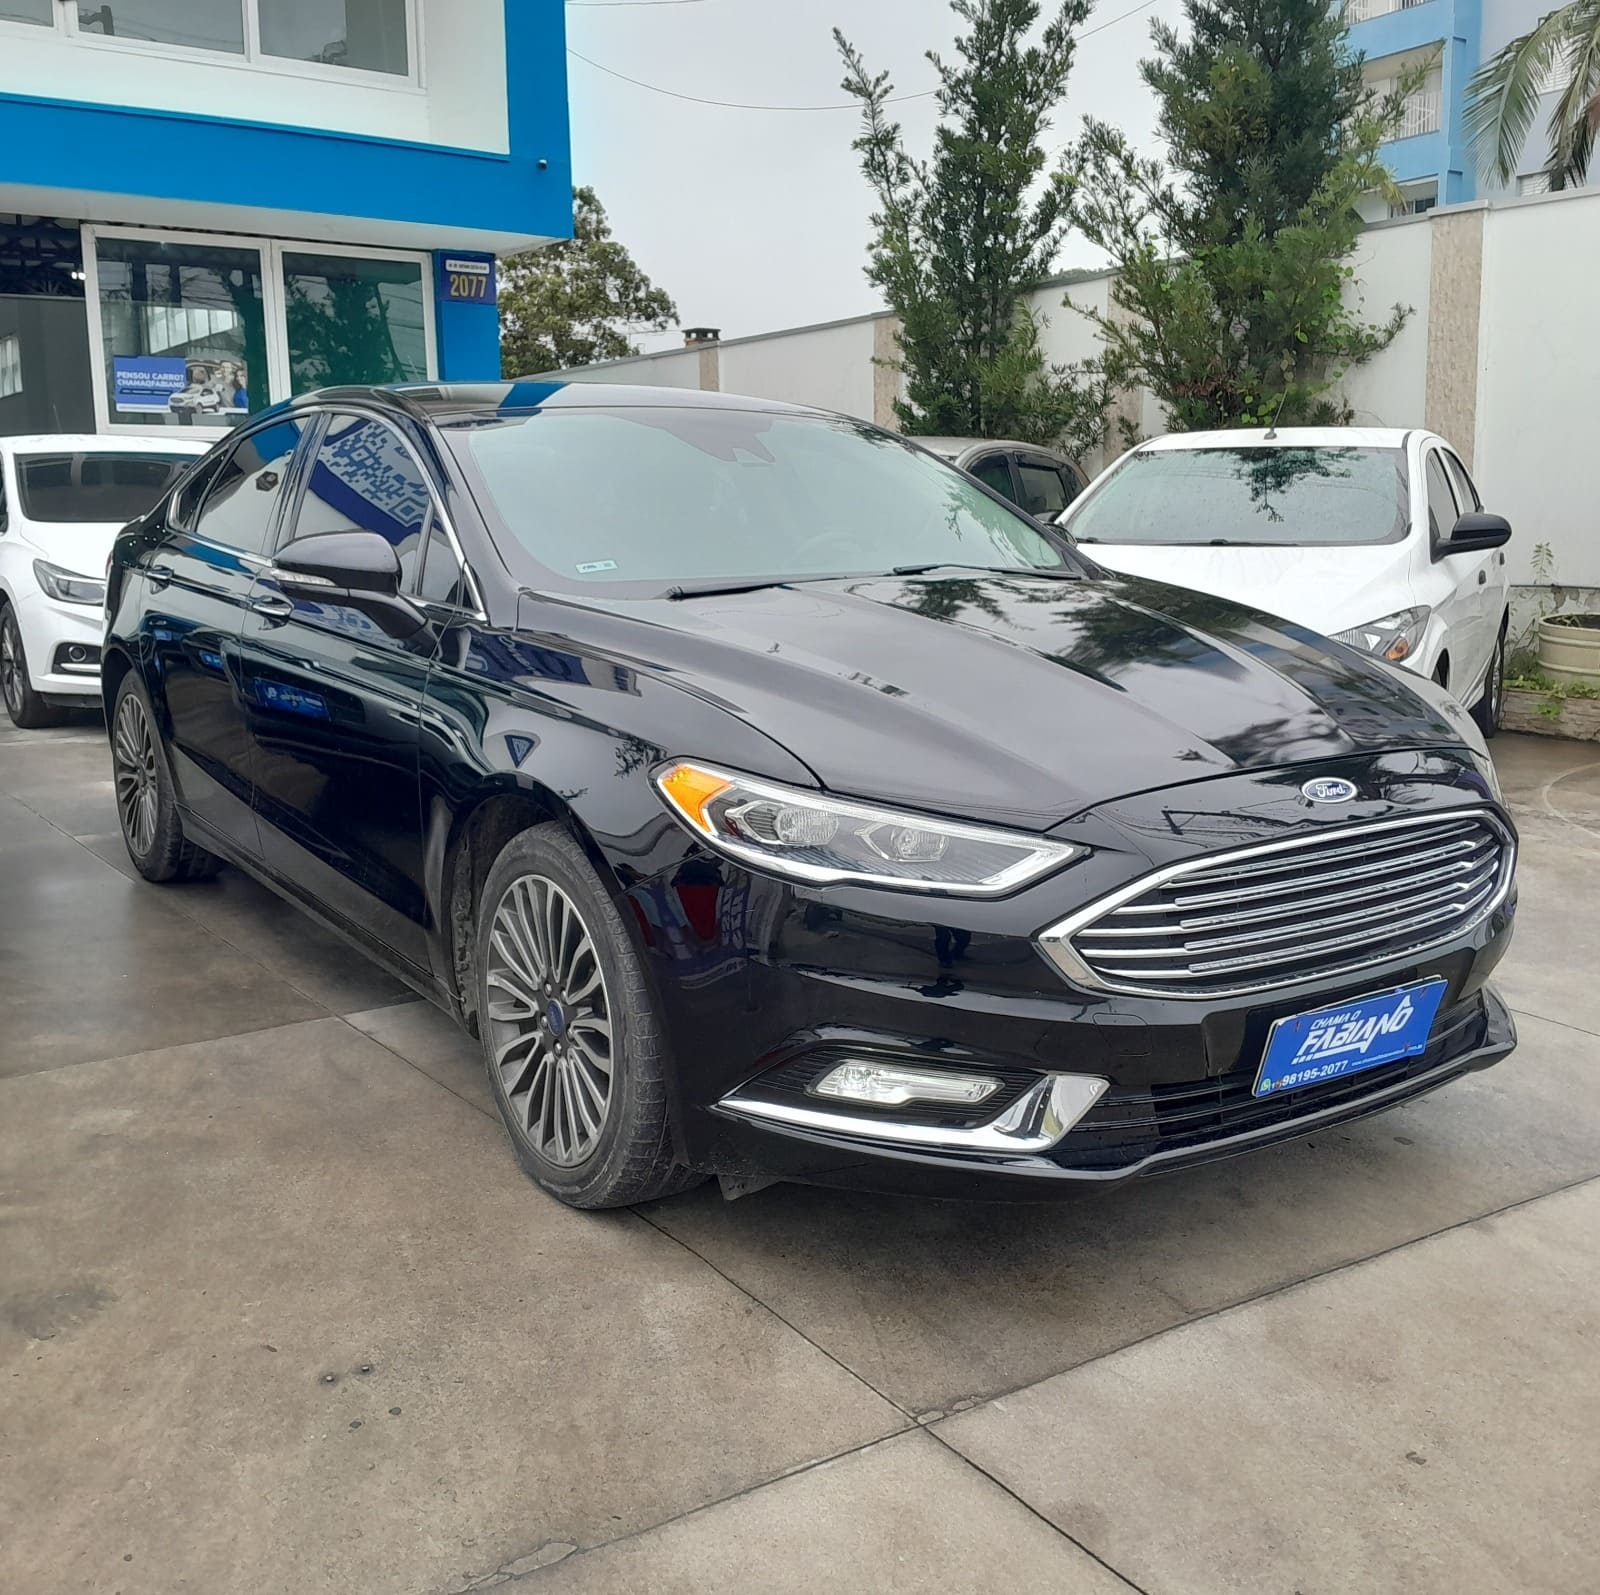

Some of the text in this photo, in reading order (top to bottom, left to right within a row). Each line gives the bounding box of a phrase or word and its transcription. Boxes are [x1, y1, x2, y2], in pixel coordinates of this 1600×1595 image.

[450, 274, 487, 298] 2077
[116, 371, 150, 380] PENSOU
[1315, 783, 1346, 798] Ford
[1310, 1009, 1362, 1030] CHAMA O
